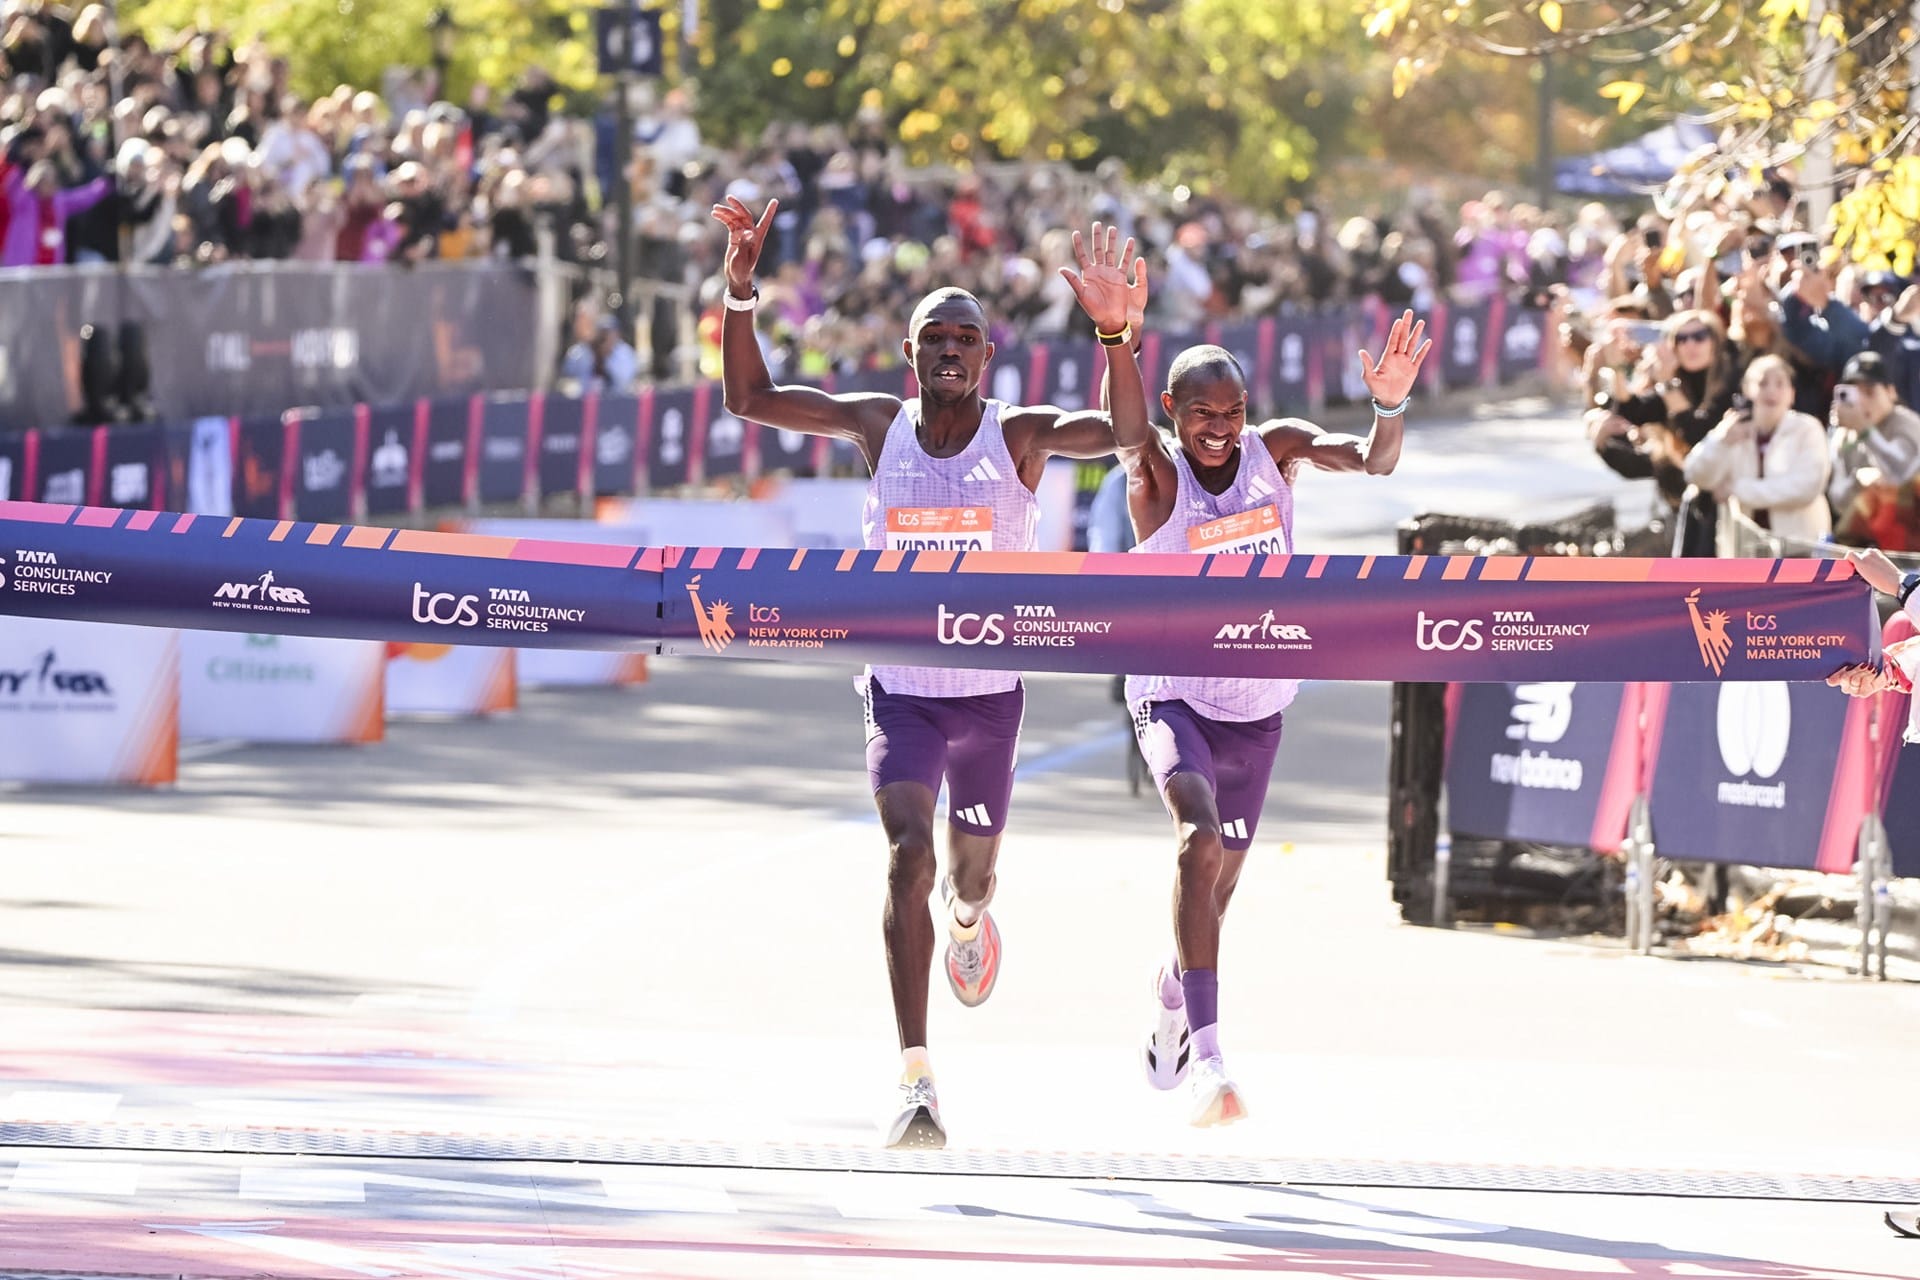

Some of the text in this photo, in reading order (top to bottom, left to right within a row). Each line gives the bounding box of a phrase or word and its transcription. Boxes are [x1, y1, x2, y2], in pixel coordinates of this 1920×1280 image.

[897, 511, 920, 526] tcs
[1199, 525, 1224, 541] tcs
[15, 549, 58, 565] TATA
[14, 565, 112, 584] CONSULTANCY
[13, 580, 76, 595] SERVICES
[488, 587, 531, 603] TATA
[232, 602, 253, 610] YORK
[253, 604, 275, 612] ROAD
[275, 606, 311, 615] RUNNERS
[412, 582, 480, 626] tcs
[1012, 604, 1056, 618] TATA
[486, 603, 586, 623] CONSULTANCY
[749, 603, 780, 623] tcs
[1492, 611, 1535, 622] TATA
[486, 617, 549, 633] SERVICES
[937, 603, 1005, 646] tcs
[1012, 620, 1113, 634] CONSULTANCY
[1746, 611, 1777, 631] tcs
[749, 627, 849, 640] NEW YORK CITY
[1416, 610, 1484, 652] tcs
[1491, 624, 1590, 637] CONSULTANCY
[748, 639, 824, 649] MARATHON
[1012, 635, 1076, 648] SERVICES
[1213, 642, 1231, 650] NEW
[1277, 643, 1313, 651] RUNNERS
[1491, 639, 1554, 652] SERVICES
[1746, 635, 1846, 646] NEW YORK CITY
[1746, 649, 1821, 660] MARATHON
